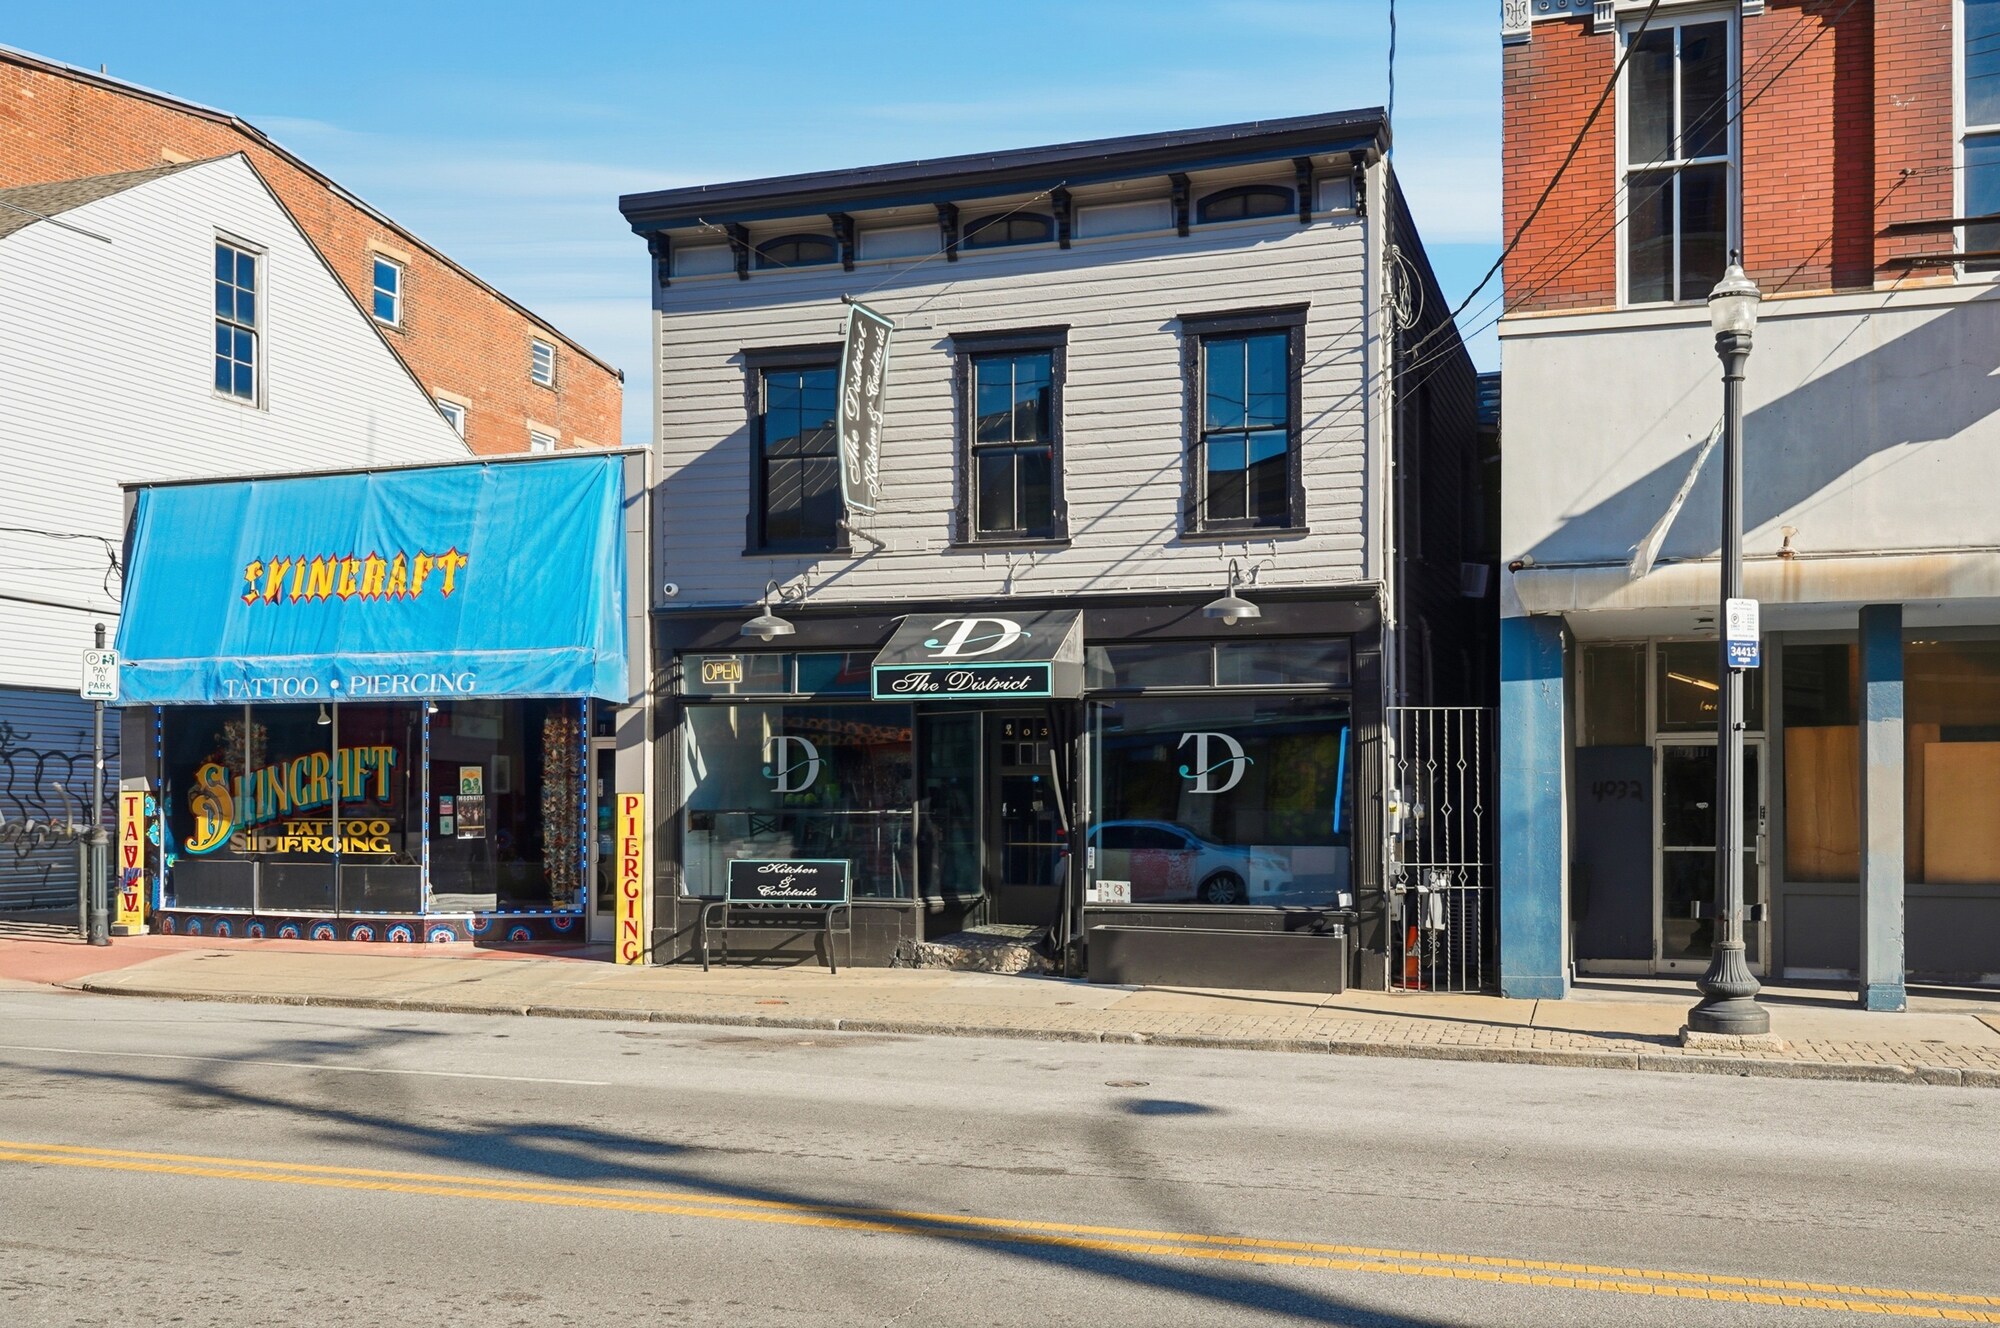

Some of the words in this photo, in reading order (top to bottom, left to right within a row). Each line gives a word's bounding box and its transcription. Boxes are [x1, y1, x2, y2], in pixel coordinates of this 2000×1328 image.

[845, 320, 867, 421] District
[844, 429, 862, 485] The
[864, 426, 880, 498] Kitchen
[241, 546, 469, 606] SKINCRAFT
[1730, 646, 1757, 657] 34413
[92, 666, 108, 674] PAY
[704, 662, 740, 680] OPEN
[88, 682, 112, 690] PARK
[223, 676, 319, 698] TATTOO
[350, 672, 477, 696] PIERCING
[892, 672, 939, 692] The
[944, 671, 1032, 691] District
[282, 820, 391, 836] TATTOO
[757, 863, 818, 874] Kitchen
[623, 796, 639, 961] PIERCING
[779, 875, 796, 888] &
[757, 885, 818, 897] Cocktails
